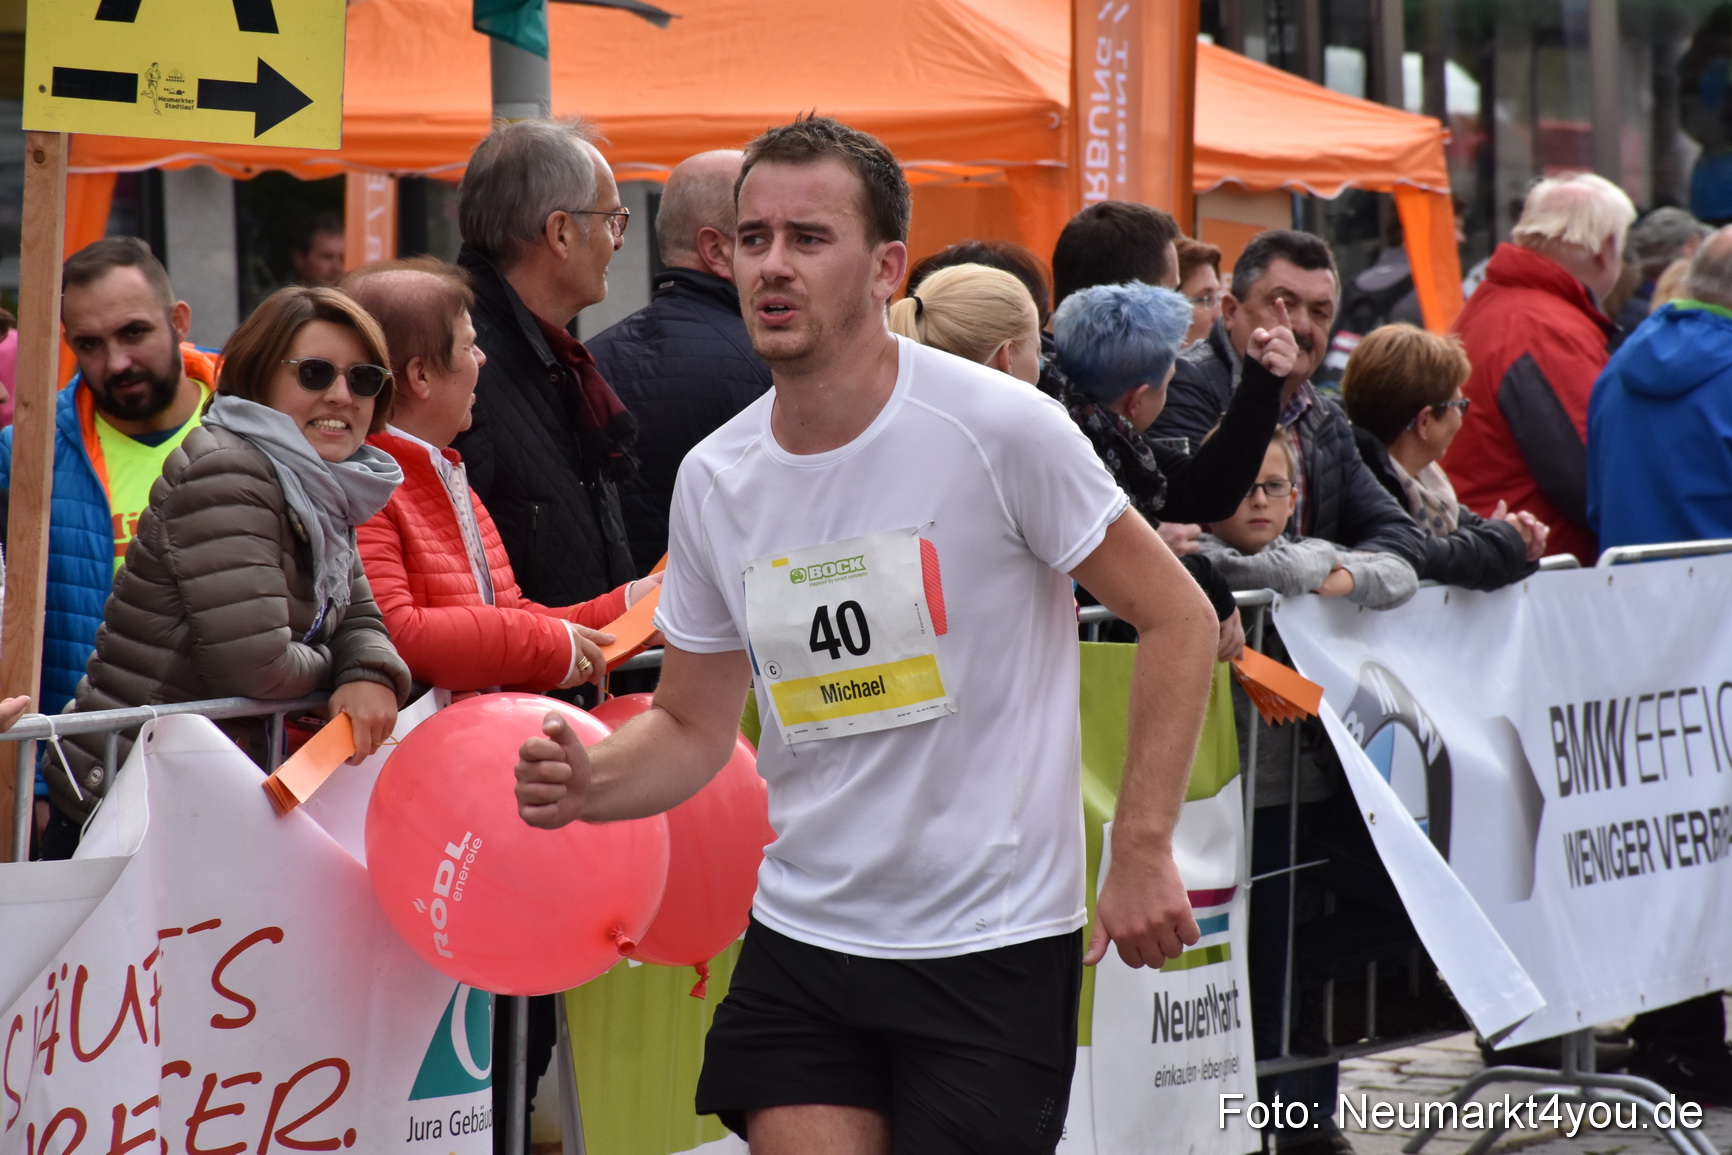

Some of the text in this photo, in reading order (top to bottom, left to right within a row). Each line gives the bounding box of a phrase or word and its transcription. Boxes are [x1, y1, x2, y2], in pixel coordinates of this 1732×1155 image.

[158, 96, 195, 104] Neumarkter
[165, 103, 194, 111] Stadtlauf
[807, 554, 867, 581] BOCK
[809, 600, 871, 660] 40
[769, 665, 777, 676] C
[820, 675, 886, 704] Michael
[1549, 697, 1632, 798] BMW
[1562, 819, 1656, 889] WENIGER
[453, 838, 483, 901] energie
[1151, 979, 1241, 1044] NeuerMart
[406, 1116, 442, 1143] Jura
